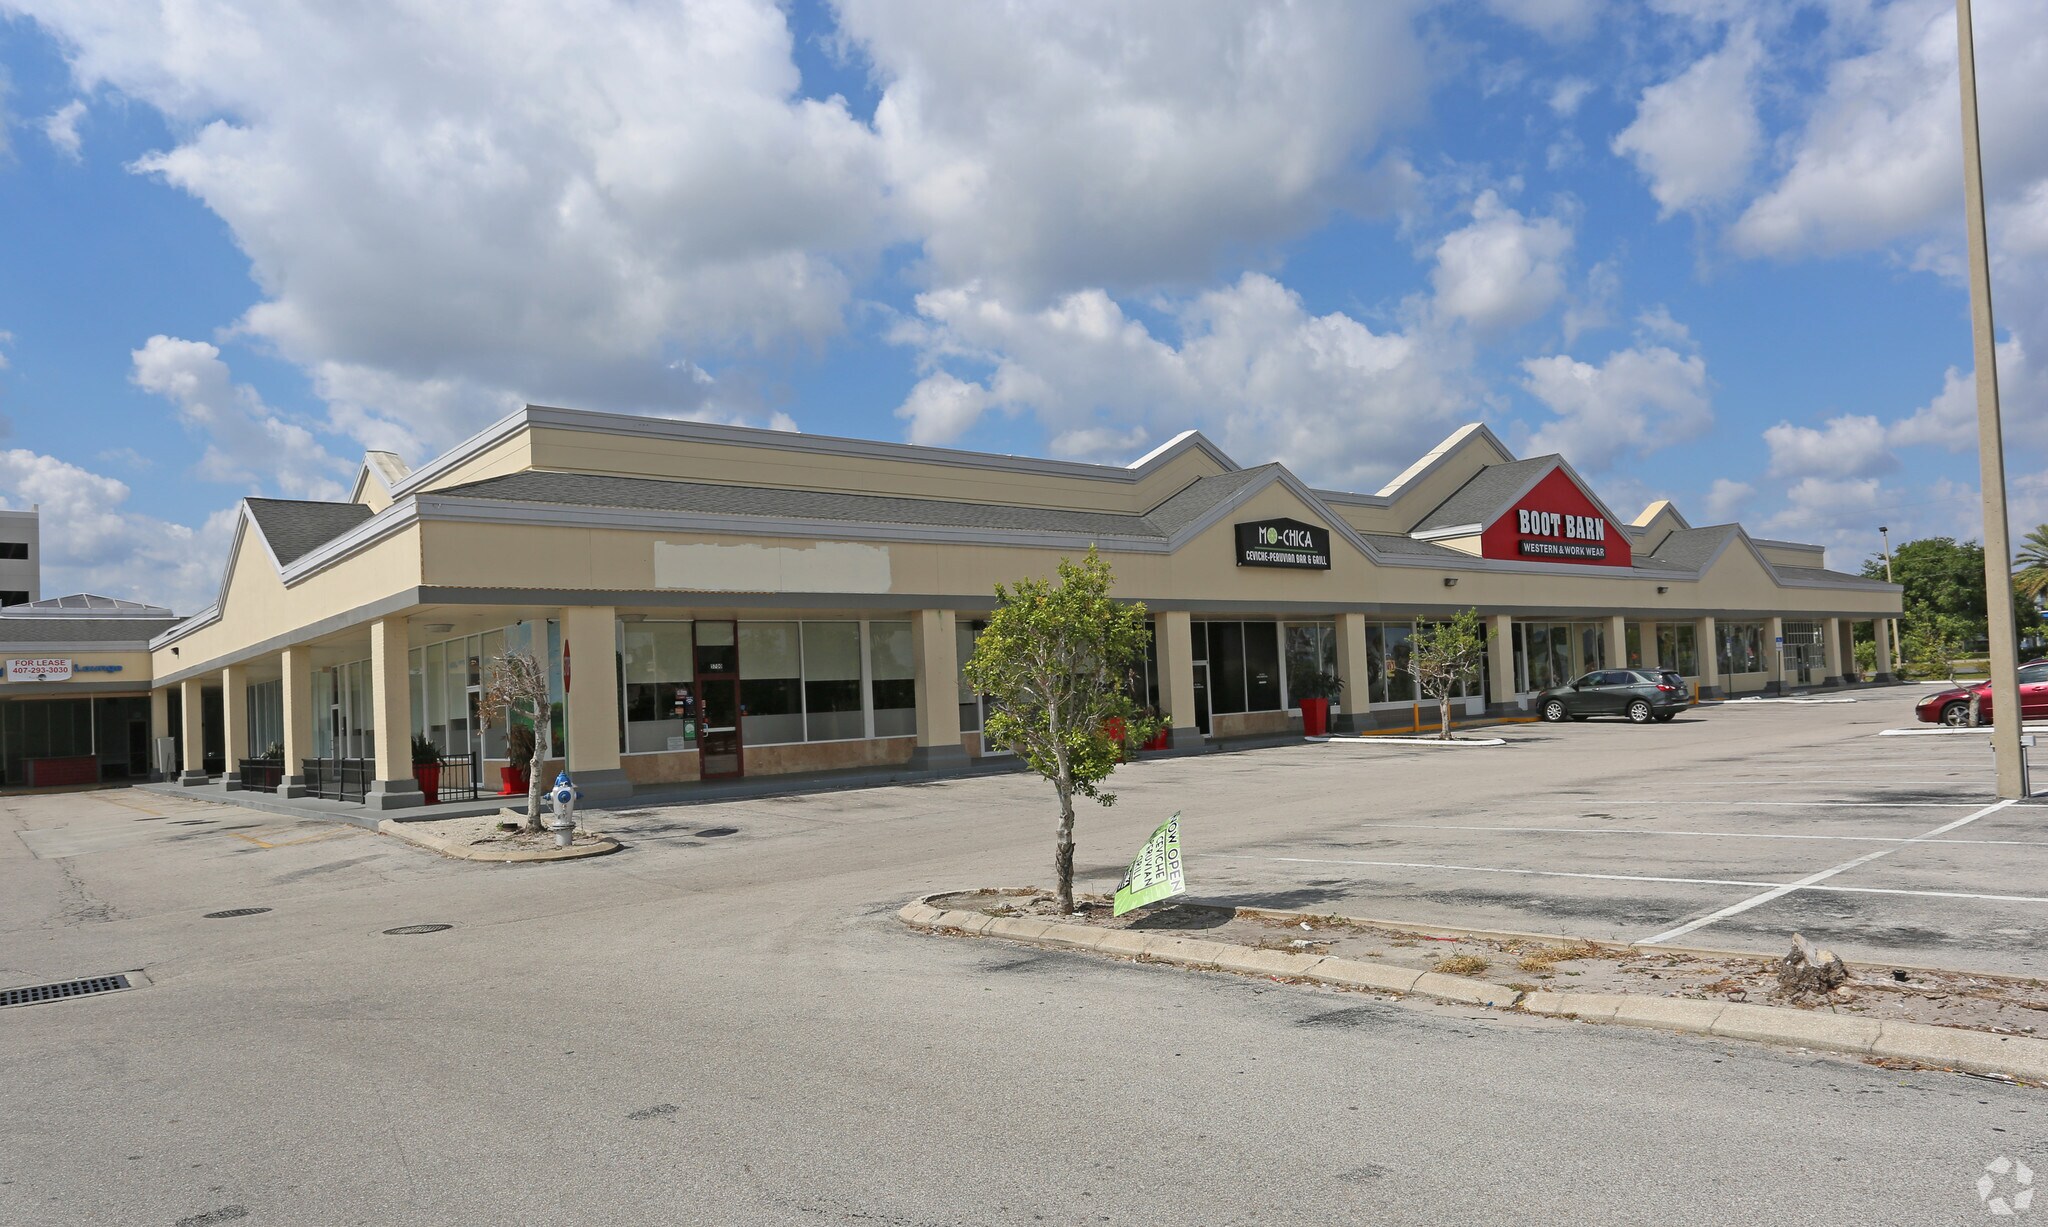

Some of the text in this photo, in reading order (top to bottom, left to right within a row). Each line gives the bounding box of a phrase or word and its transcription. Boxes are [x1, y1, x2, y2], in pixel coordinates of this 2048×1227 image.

[1258, 526, 1313, 547] MO-CHICA
[1519, 509, 1604, 540] BOOT BARN
[1296, 554, 1307, 563] BAR
[1307, 555, 1311, 564] &
[1312, 555, 1327, 565] GRILL
[1523, 543, 1605, 556] WESTERN & WORK WEAR
[1155, 836, 1165, 879] CEVICHE
[1168, 849, 1182, 892] OPEN
